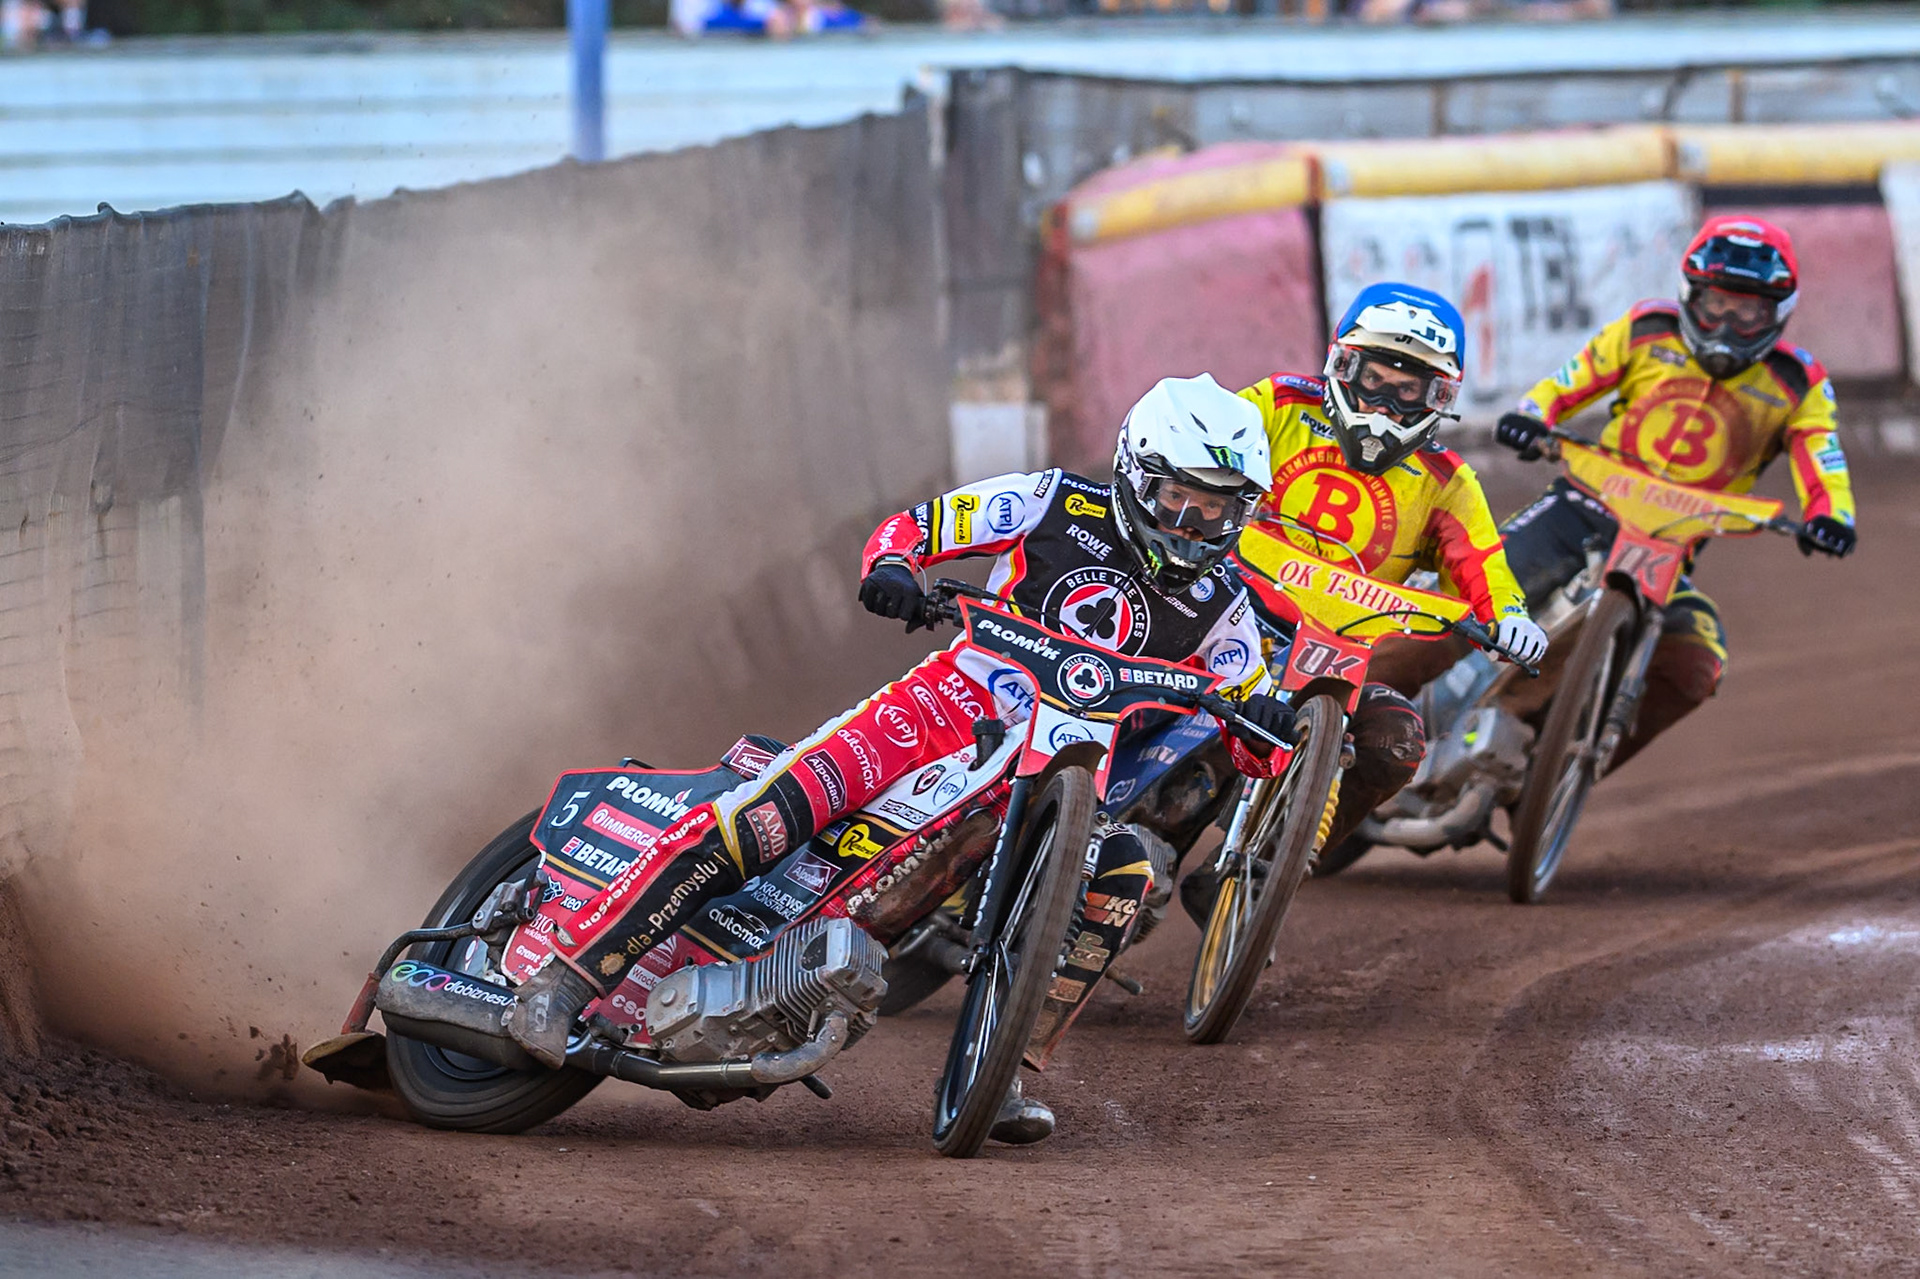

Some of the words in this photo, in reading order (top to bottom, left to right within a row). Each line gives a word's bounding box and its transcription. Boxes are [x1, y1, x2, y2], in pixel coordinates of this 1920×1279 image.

[1653, 404, 1717, 467] B
[1275, 451, 1347, 485] BIRMINGHA
[998, 496, 1013, 527] ATPI
[1296, 472, 1361, 545] B
[1066, 523, 1112, 557] ROWE
[1066, 571, 1107, 588] BELLE
[1133, 604, 1145, 638] ACES
[1279, 560, 1320, 589] OK
[1325, 571, 1420, 625] T-SHIRT
[1212, 648, 1243, 669] ATPI
[1133, 669, 1198, 689] BETARD
[809, 758, 841, 810] Alpodach
[551, 791, 591, 827] 5
[600, 816, 658, 849] IMMERGA
[751, 814, 770, 858] GROUP
[759, 808, 786, 856] AMD
[574, 843, 631, 877] BETAR
